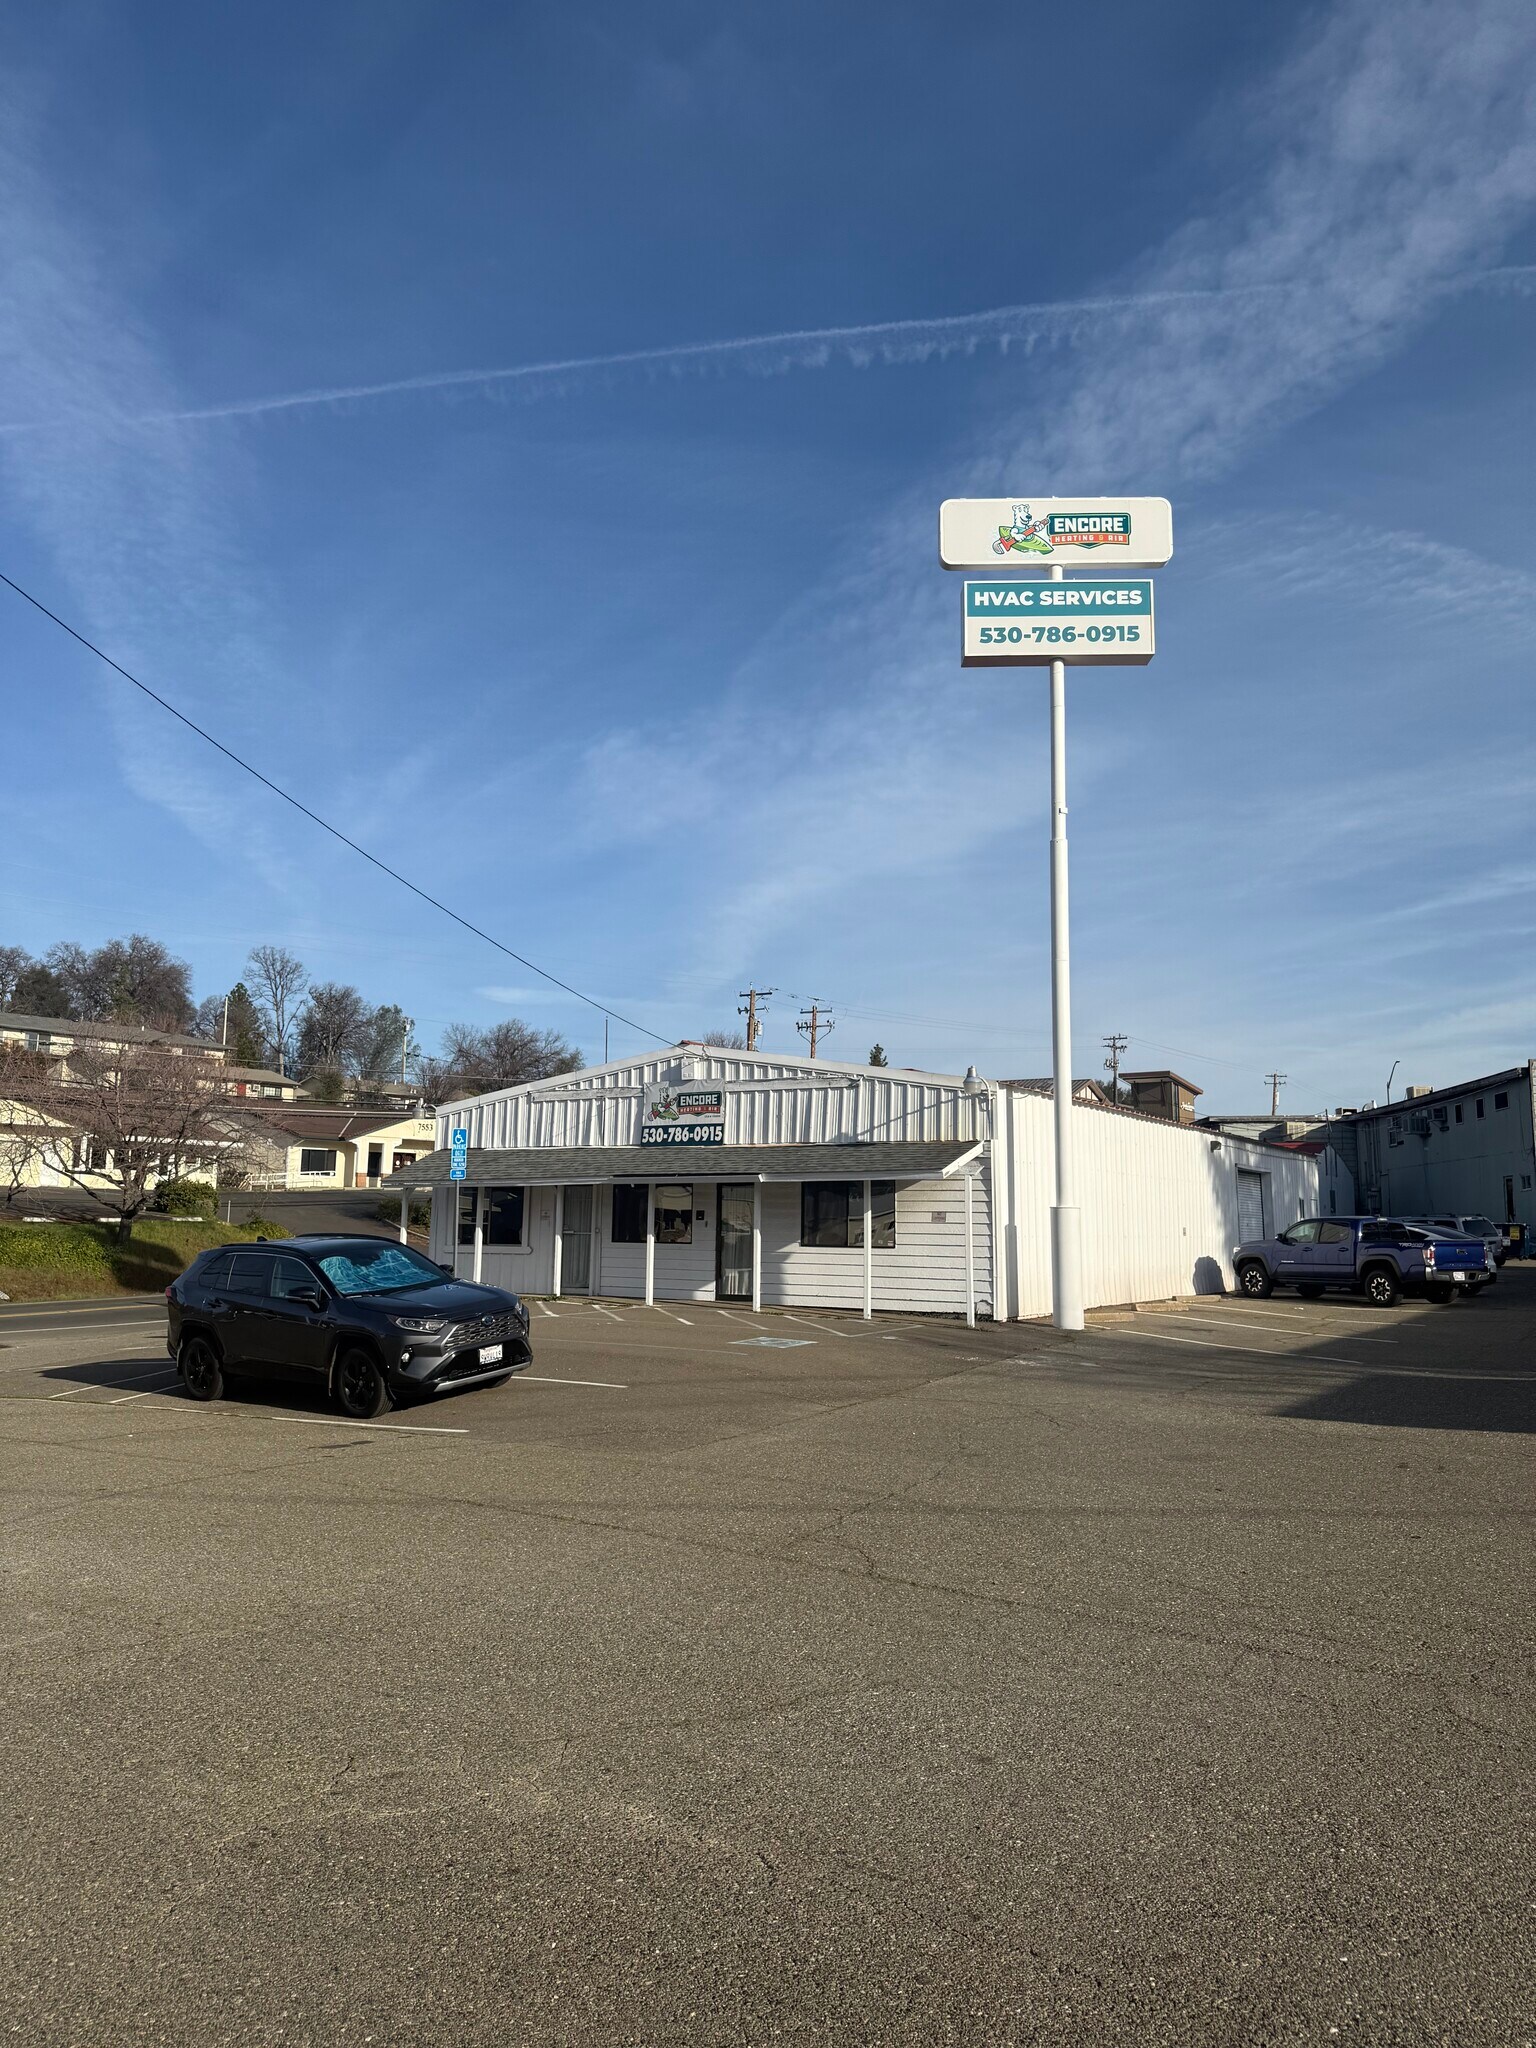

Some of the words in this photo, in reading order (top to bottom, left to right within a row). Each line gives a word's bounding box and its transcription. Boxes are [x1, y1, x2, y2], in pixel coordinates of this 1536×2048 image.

[1054, 517, 1124, 533] ENCORE
[974, 591, 1034, 606] HVAC
[1039, 590, 1143, 606] SERVICES
[979, 625, 1141, 644] 530-786-0915
[680, 1094, 718, 1106] ENCORE
[417, 1123, 434, 1131] 7553
[641, 1126, 723, 1143] 530-786-0915
